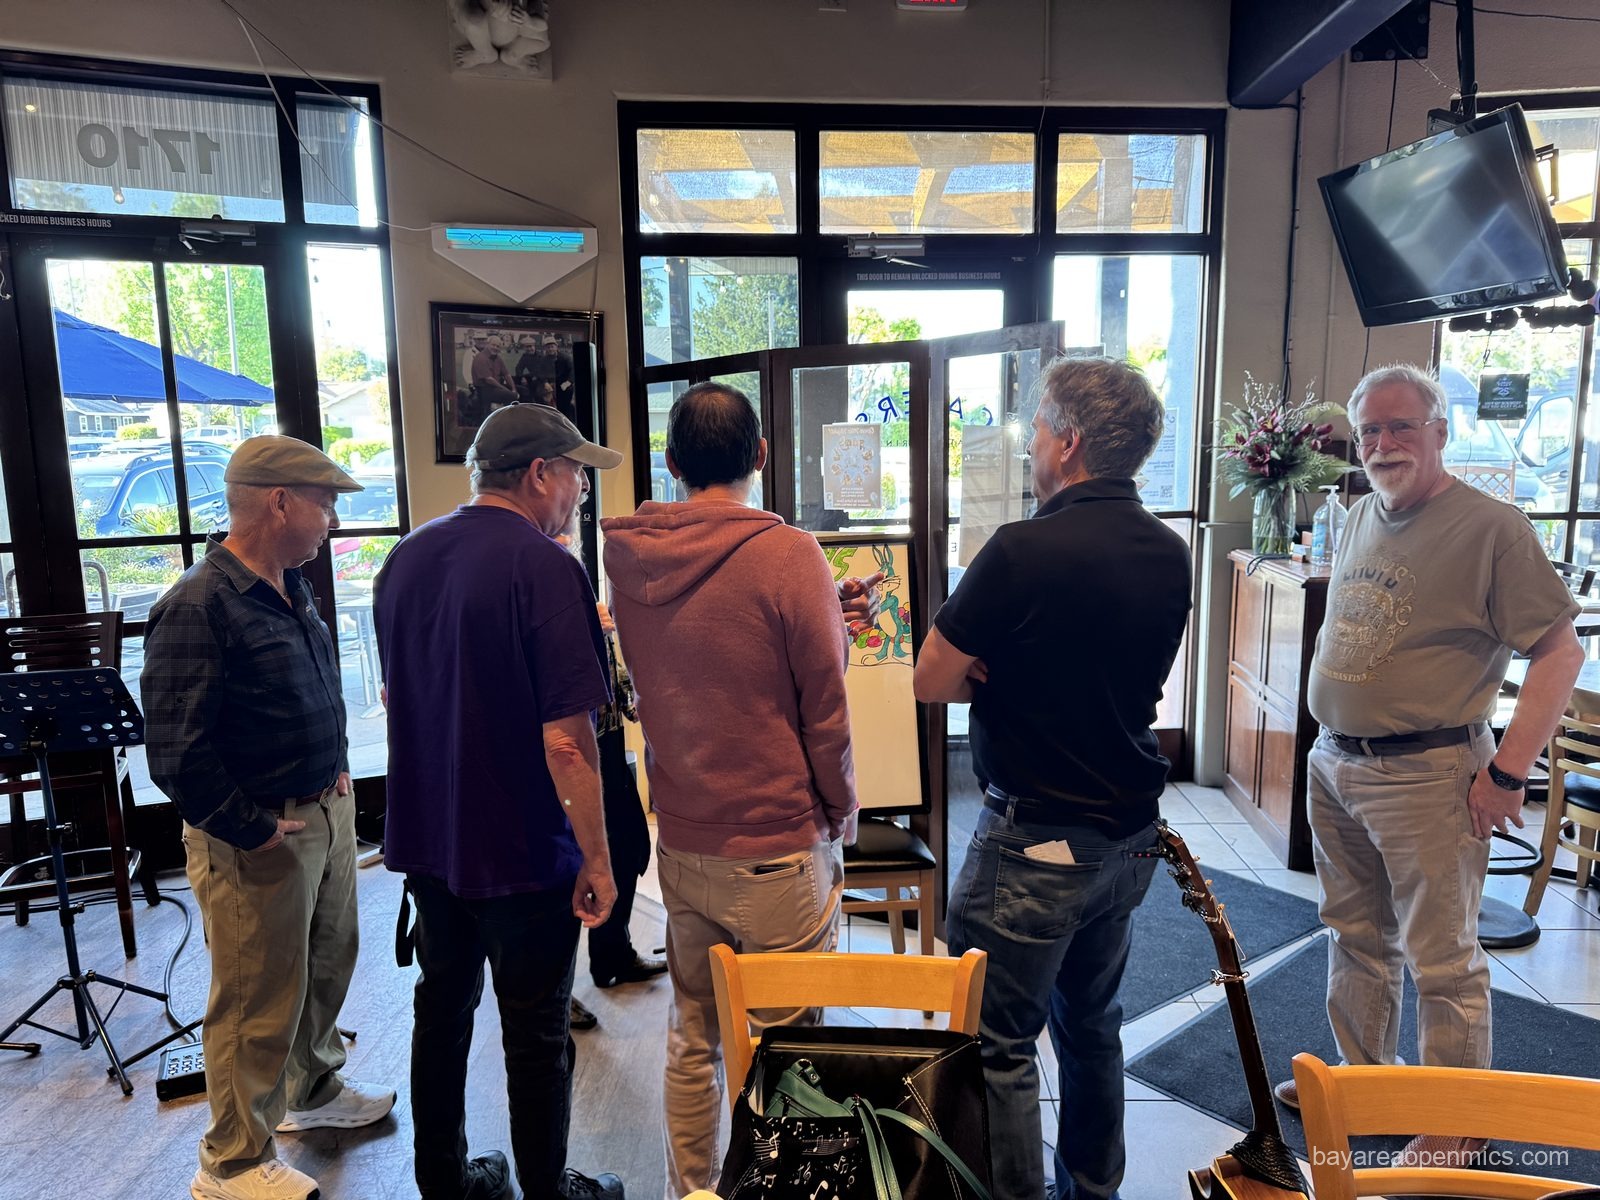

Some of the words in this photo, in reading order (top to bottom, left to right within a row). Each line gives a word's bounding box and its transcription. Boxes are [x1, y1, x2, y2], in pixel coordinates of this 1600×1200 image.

[20, 215, 49, 225] DURING
[50, 216, 86, 227] BUSINESS
[87, 218, 112, 228] HOURS
[856, 273, 868, 281] THIS
[911, 272, 937, 280] UNLOCKED
